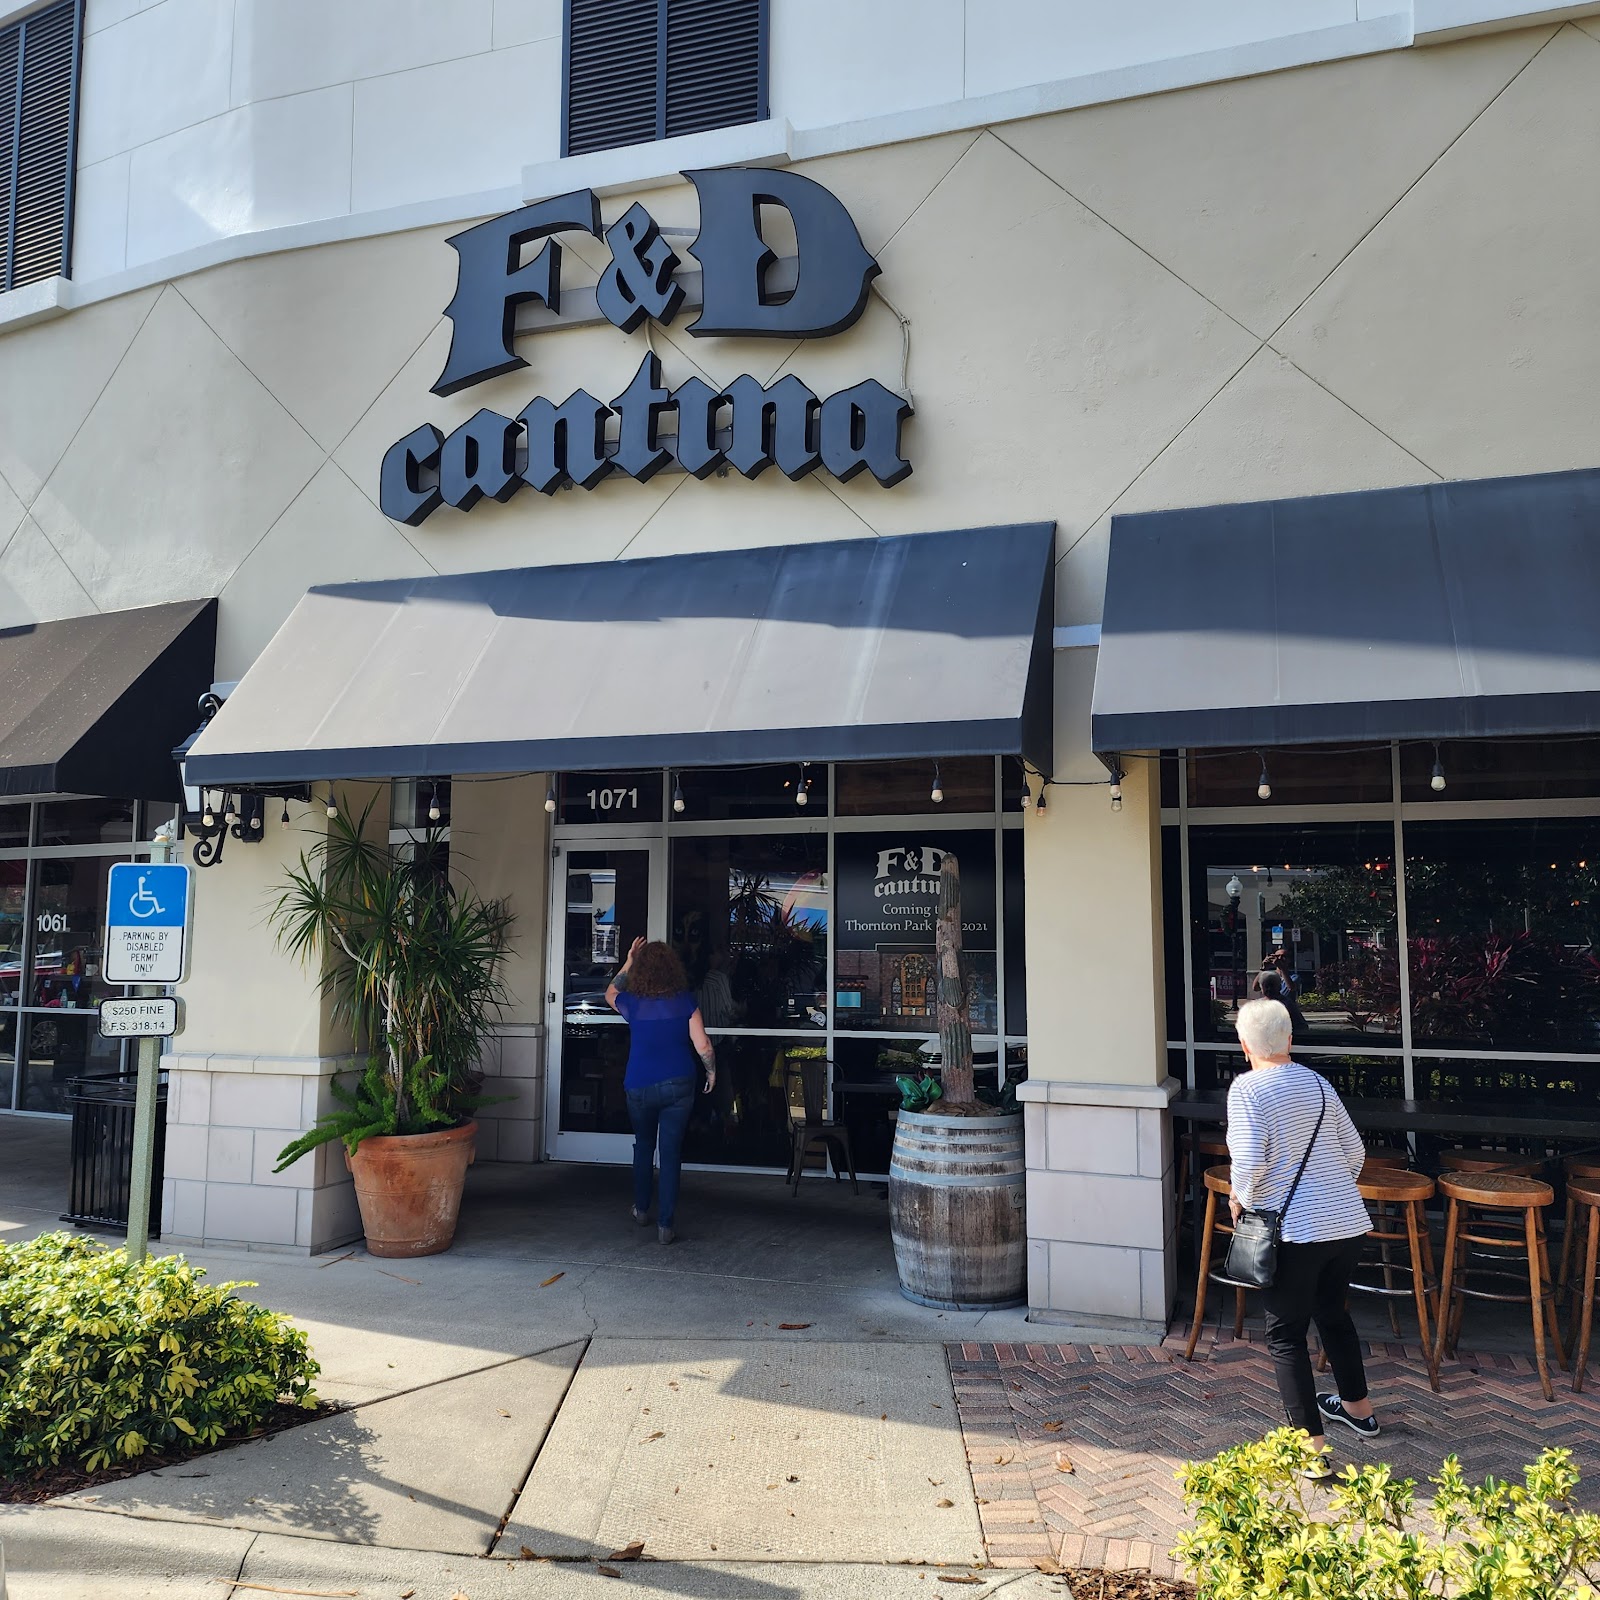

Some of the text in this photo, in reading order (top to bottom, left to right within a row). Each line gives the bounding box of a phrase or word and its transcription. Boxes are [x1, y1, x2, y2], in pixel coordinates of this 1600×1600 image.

[429, 167, 882, 398] F&D
[380, 350, 915, 527] cantina
[587, 788, 638, 809] 1071
[874, 875, 941, 898] cantin
[882, 903, 932, 917] Coming
[36, 913, 68, 932] 1061
[845, 919, 901, 931] Thornton
[903, 919, 933, 931] Park
[961, 922, 988, 931] 2021
[123, 931, 169, 941] PARKING BY
[126, 942, 164, 952] DISABLED
[130, 953, 159, 962] PERMIT
[134, 963, 154, 973] ONLY
[139, 1005, 164, 1015] FINE
[111, 1021, 165, 1031] F.S. 318.14
